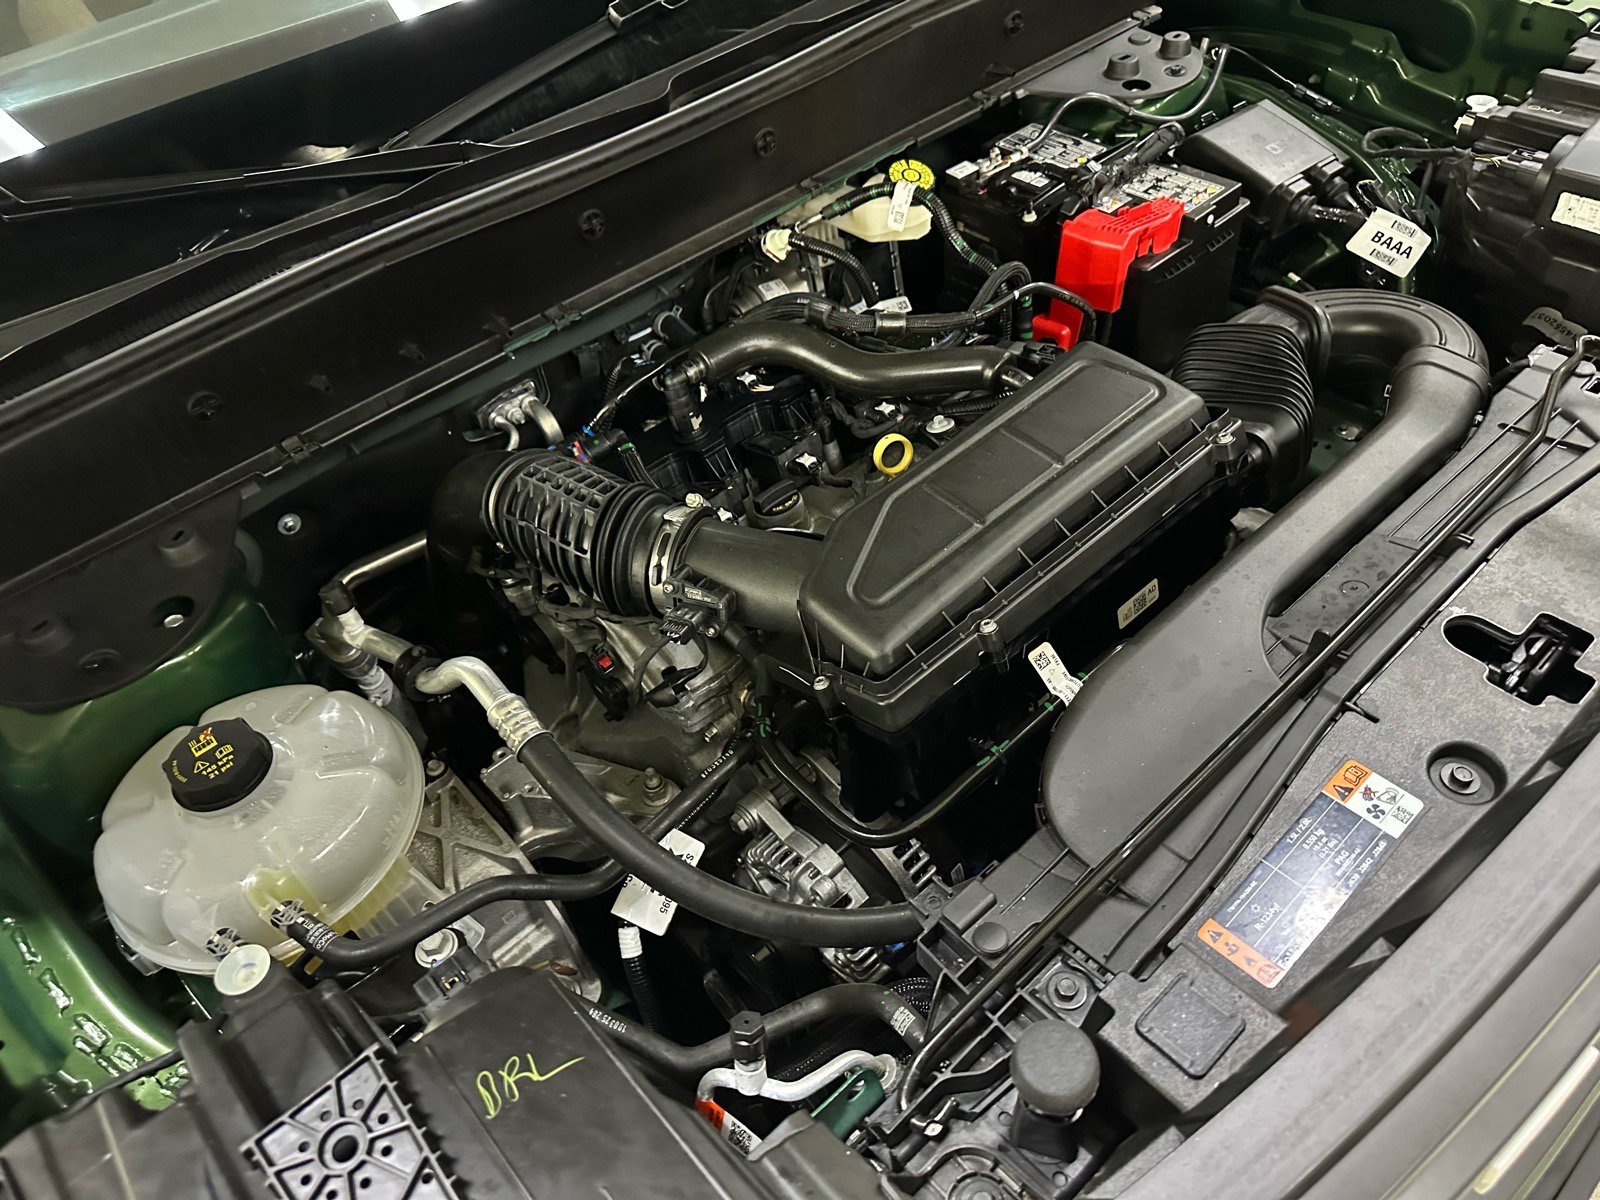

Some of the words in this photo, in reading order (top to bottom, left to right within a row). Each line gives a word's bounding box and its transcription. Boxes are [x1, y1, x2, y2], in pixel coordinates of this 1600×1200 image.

[1370, 230, 1413, 259] BAAA
[200, 762, 217, 775] 145
[217, 753, 234, 766] kPa
[208, 769, 219, 779] 21
[220, 760, 234, 772] psi
[1312, 825, 1326, 839] kg
[1333, 848, 1350, 866] PAG
